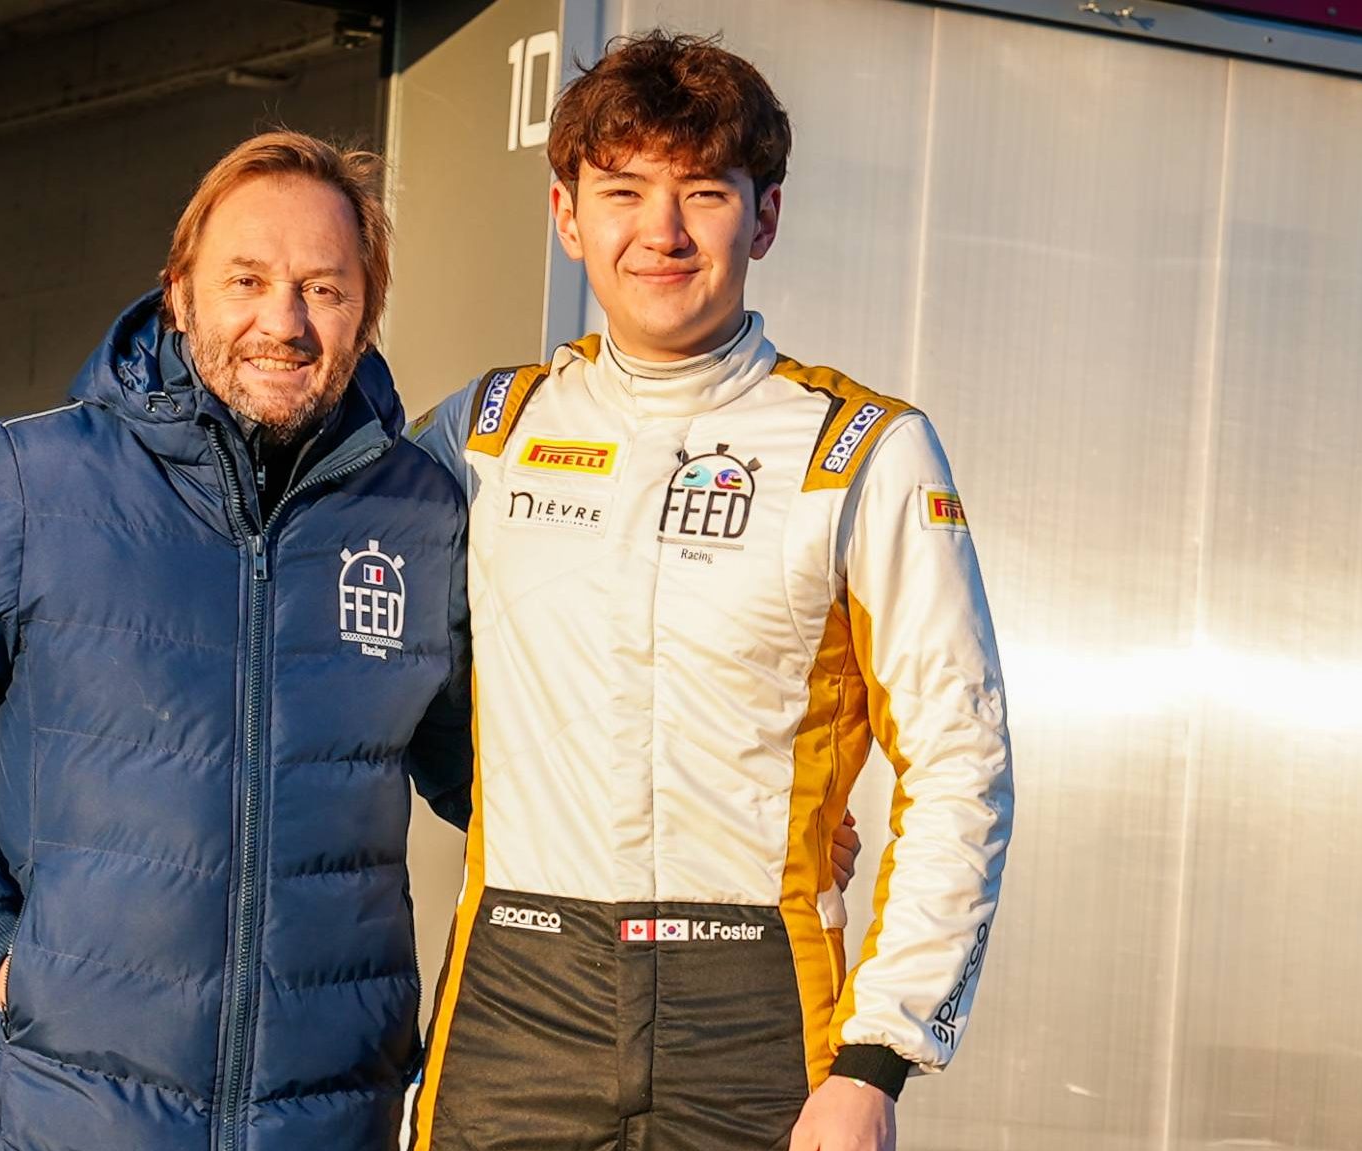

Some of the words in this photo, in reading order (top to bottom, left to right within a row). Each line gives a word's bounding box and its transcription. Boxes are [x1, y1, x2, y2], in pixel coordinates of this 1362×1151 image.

[508, 30, 559, 151] 10
[481, 372, 515, 433] sparco
[528, 445, 608, 468] PIRELLI
[825, 403, 880, 471] sparco
[659, 487, 753, 539] FEED
[680, 548, 714, 565] Racing
[340, 585, 405, 639] FEED
[492, 905, 561, 929] sparco
[692, 921, 764, 940] K.Foster
[931, 922, 987, 1044] sparco
